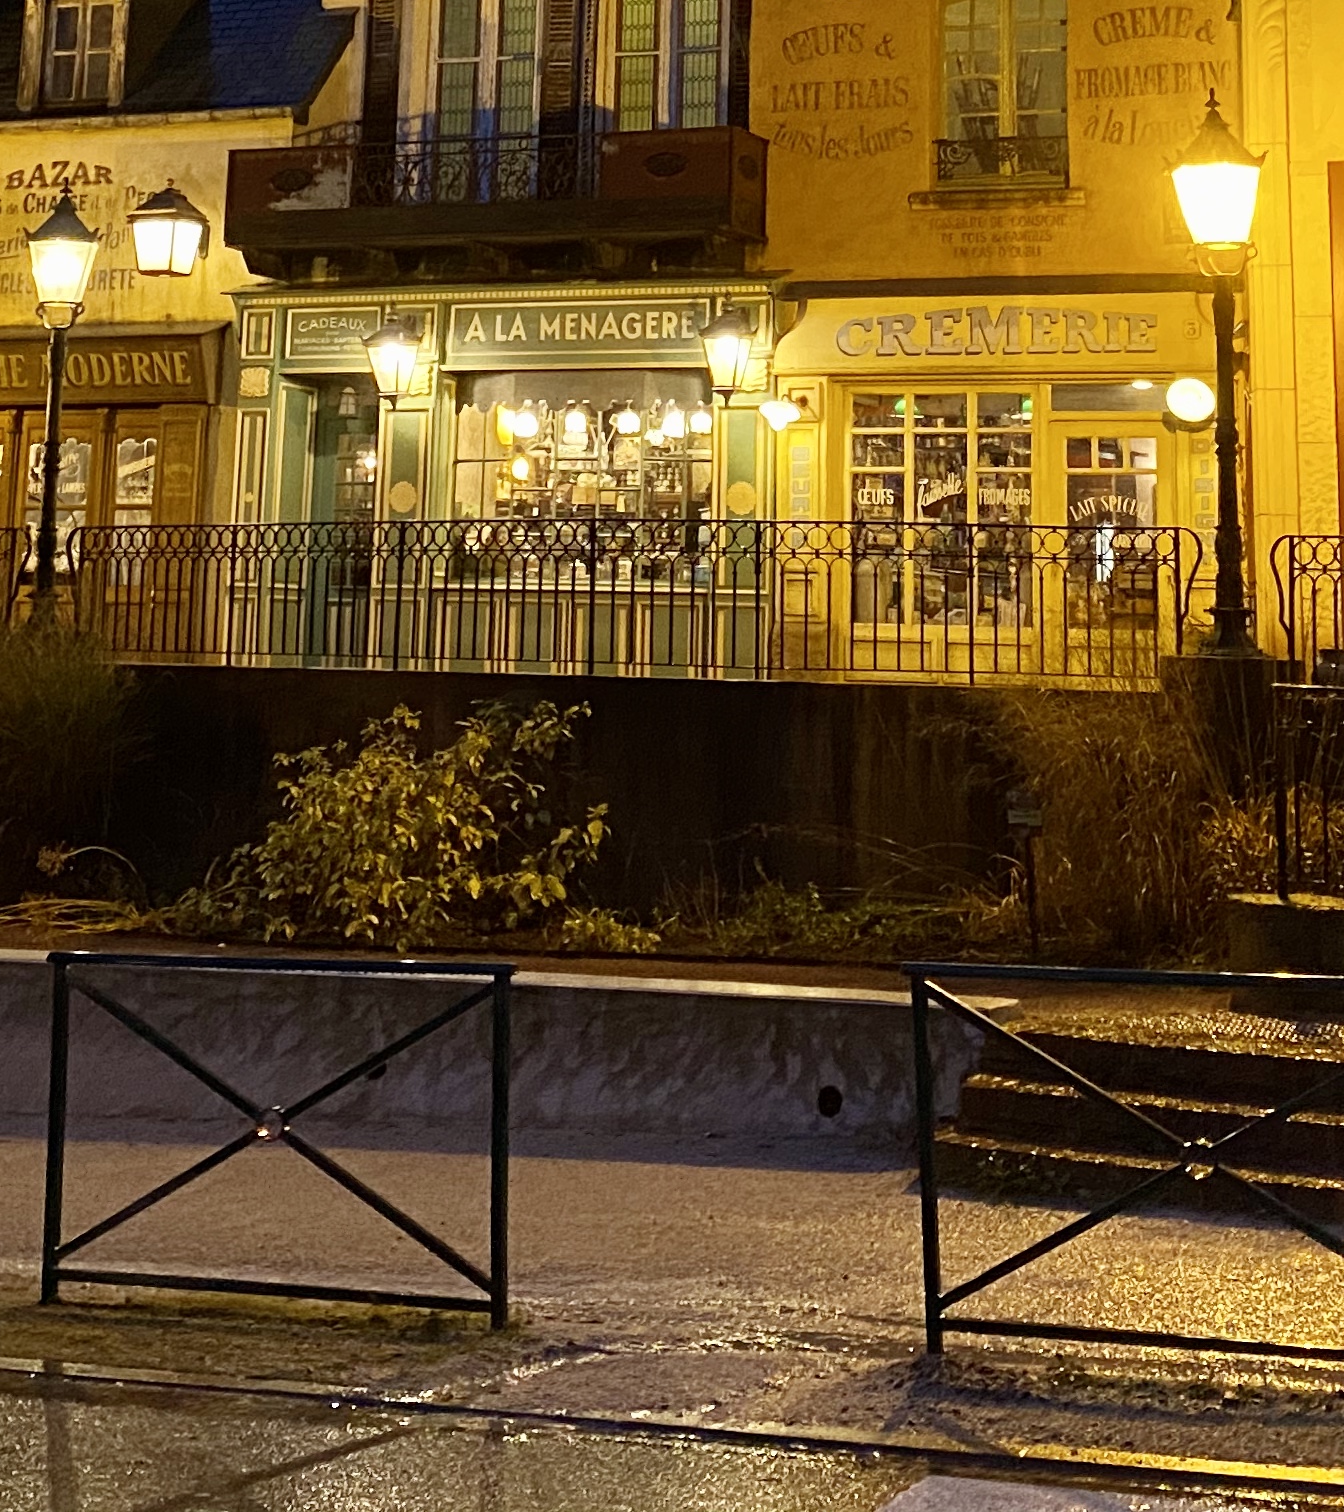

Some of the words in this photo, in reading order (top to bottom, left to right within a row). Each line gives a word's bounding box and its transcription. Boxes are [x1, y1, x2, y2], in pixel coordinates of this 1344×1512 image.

[1093, 5, 1194, 47] CREME
[770, 81, 826, 113] LAIT
[832, 75, 910, 110] FRAIS
[1073, 63, 1169, 100] FROMAGE
[1171, 59, 1232, 94] BLANC
[5, 160, 113, 190] BAZAR
[298, 317, 367, 333] CADEAUX
[463, 311, 487, 342] A
[495, 311, 528, 342] LA
[539, 310, 696, 342] MENAGERE
[836, 305, 1159, 358] CREMERIE
[858, 488, 895, 506] ŒUFS
[978, 488, 1031, 506] FROMAGES
